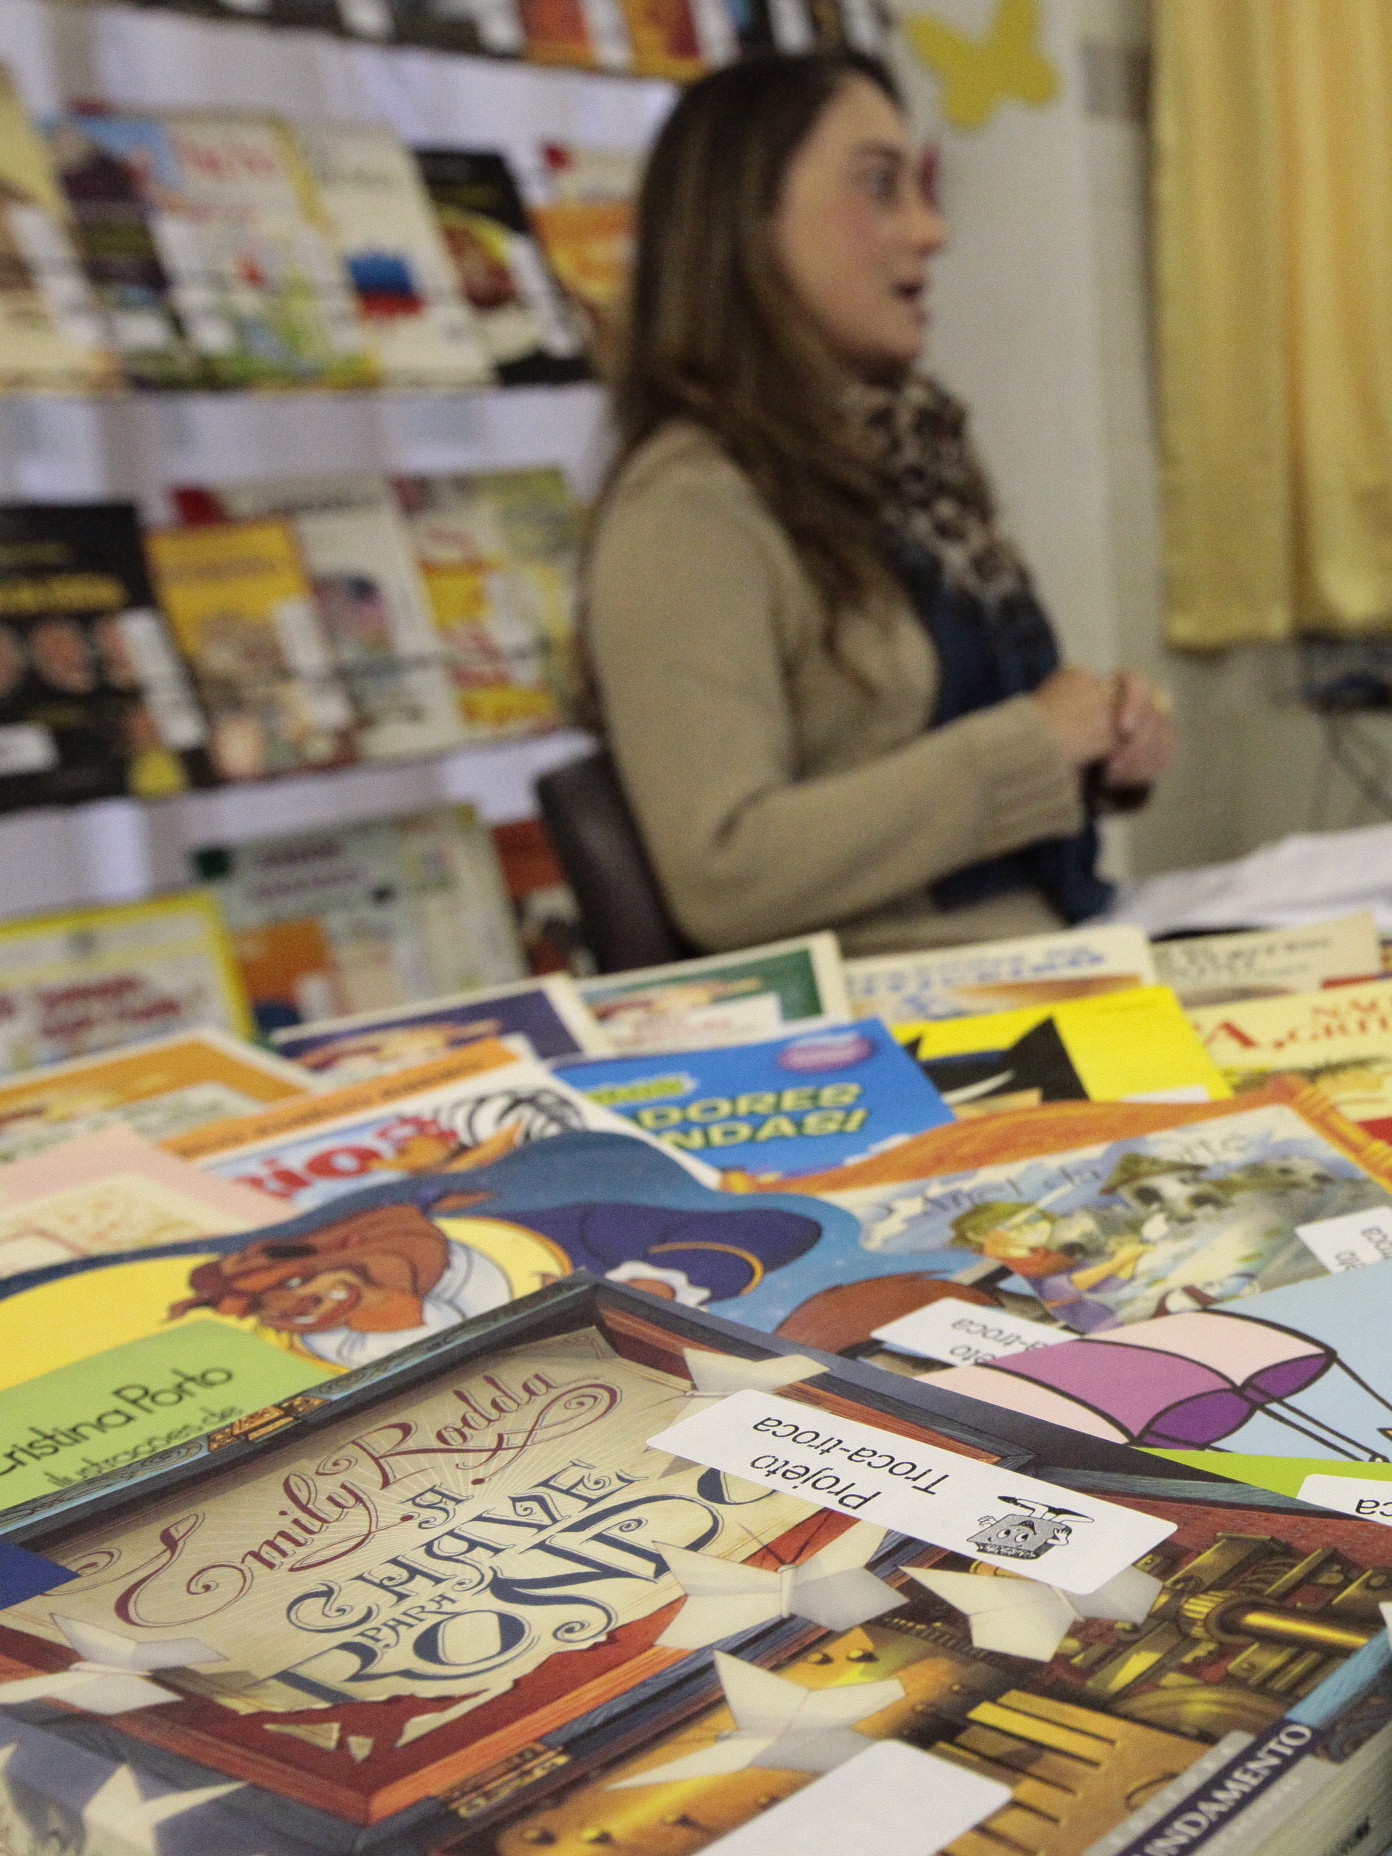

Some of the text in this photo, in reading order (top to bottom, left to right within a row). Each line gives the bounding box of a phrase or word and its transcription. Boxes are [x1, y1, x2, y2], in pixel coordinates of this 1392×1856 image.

[112, 1366, 234, 1415] Porto
[314, 1370, 622, 1490] Rodda
[751, 1415, 951, 1496] Troca-troca
[750, 1453, 883, 1512] Projeto
